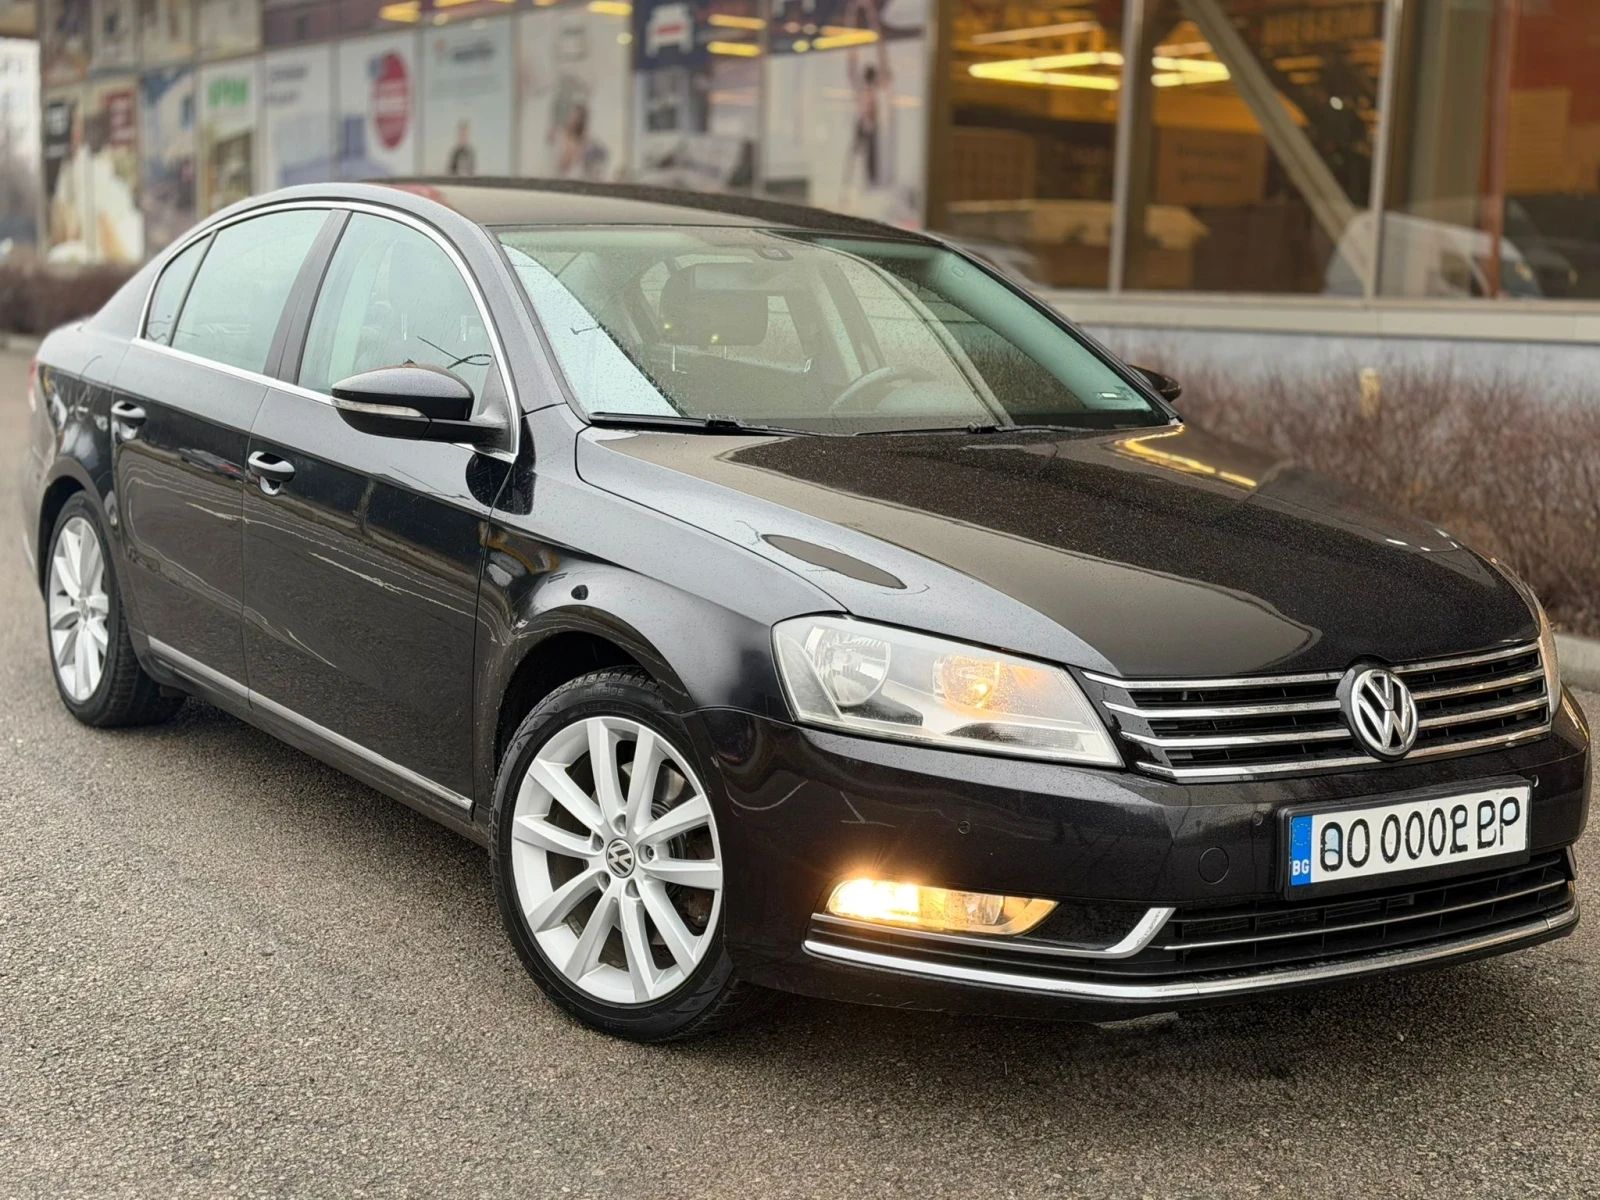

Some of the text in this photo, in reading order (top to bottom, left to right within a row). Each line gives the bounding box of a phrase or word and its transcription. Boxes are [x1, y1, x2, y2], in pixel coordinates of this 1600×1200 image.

[582, 686, 625, 698] OUTSIDE
[1352, 669, 1418, 755] VW
[607, 838, 635, 878] VW
[1292, 860, 1310, 876] BG
